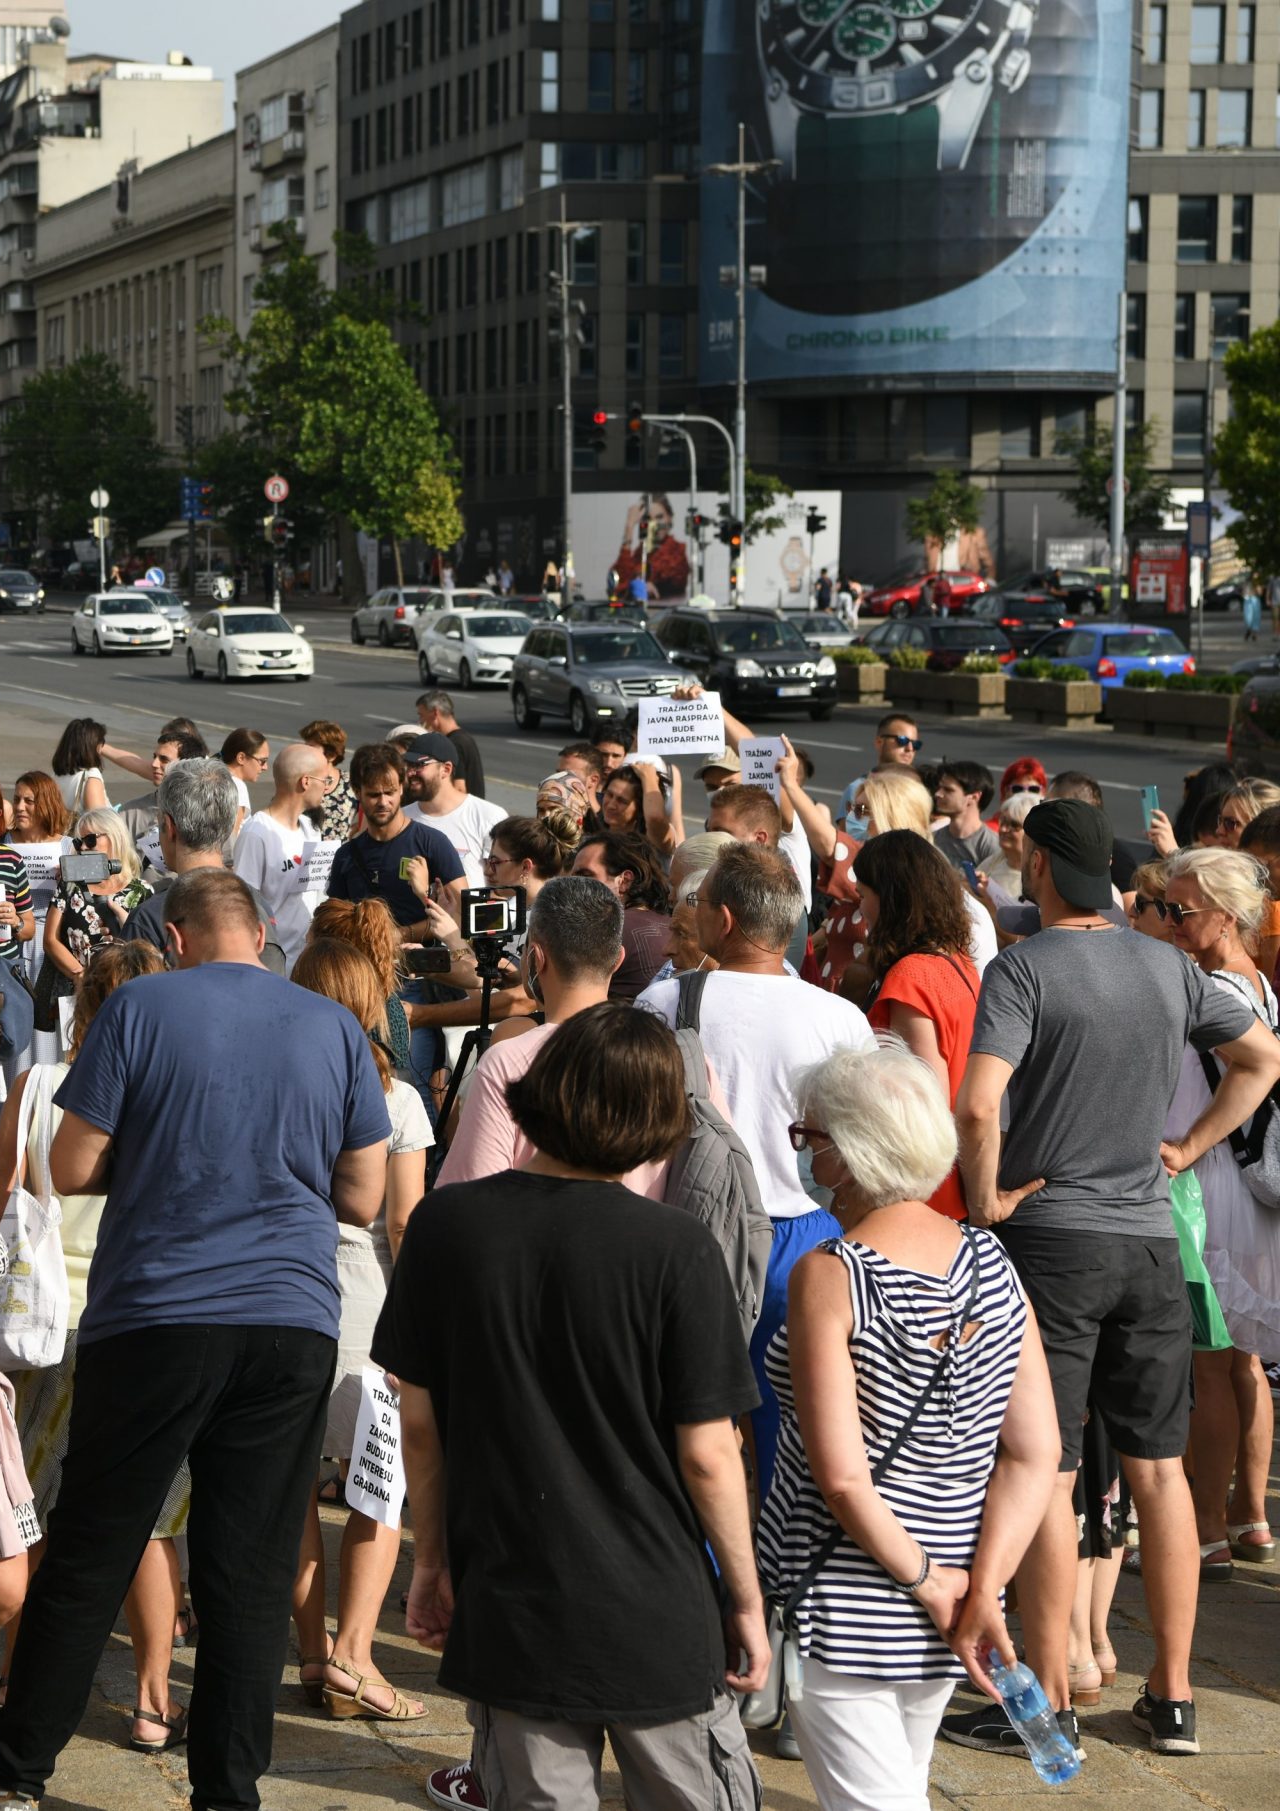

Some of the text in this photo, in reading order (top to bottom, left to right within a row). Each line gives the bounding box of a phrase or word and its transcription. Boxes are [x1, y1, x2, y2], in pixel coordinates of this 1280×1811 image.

[786, 325, 951, 350] CHRONO BIKE
[658, 703, 709, 714] TRAŽIMO DA
[647, 714, 720, 725] JAVNA RASPRAVA
[672, 725, 695, 733] BUDE
[648, 735, 720, 745] TRANSPARENTNA
[745, 749, 773, 757] TRAŽIMO
[281, 858, 295, 872] JA
[381, 1412, 392, 1428] DA
[368, 1424, 398, 1449] ZAKONI
[365, 1440, 394, 1465] BUDU U
[358, 1455, 394, 1483] INTERESU
[353, 1474, 391, 1504] GRAĐANA
